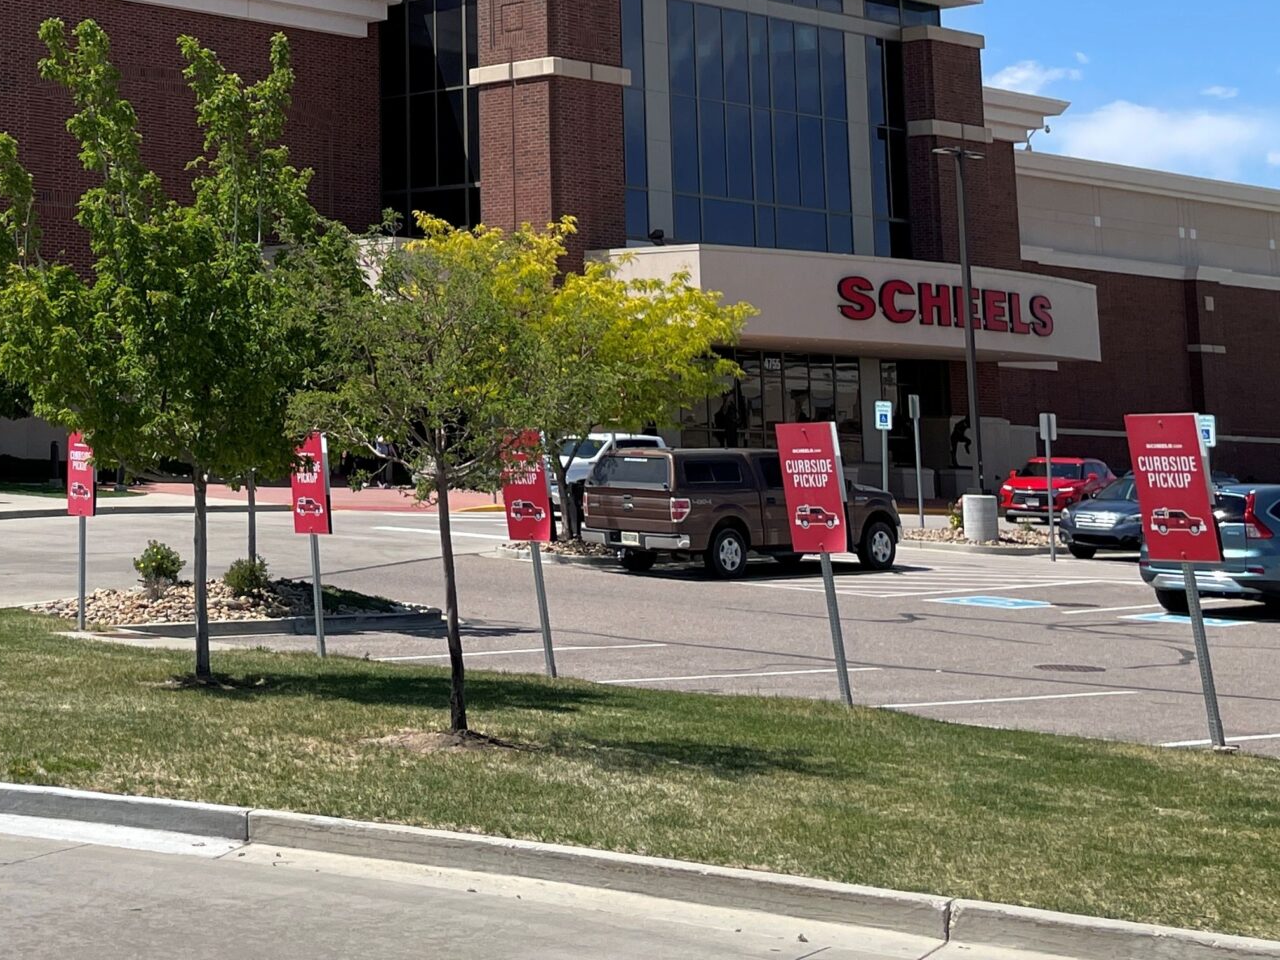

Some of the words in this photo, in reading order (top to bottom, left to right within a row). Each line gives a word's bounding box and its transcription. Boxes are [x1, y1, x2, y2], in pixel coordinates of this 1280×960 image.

[837, 276, 1054, 337] SCHEELS
[785, 459, 833, 473] CURBSIDE
[1137, 456, 1197, 471] CURBSIDE
[793, 474, 828, 487] PICKUP
[1147, 473, 1191, 488] PICKUP
